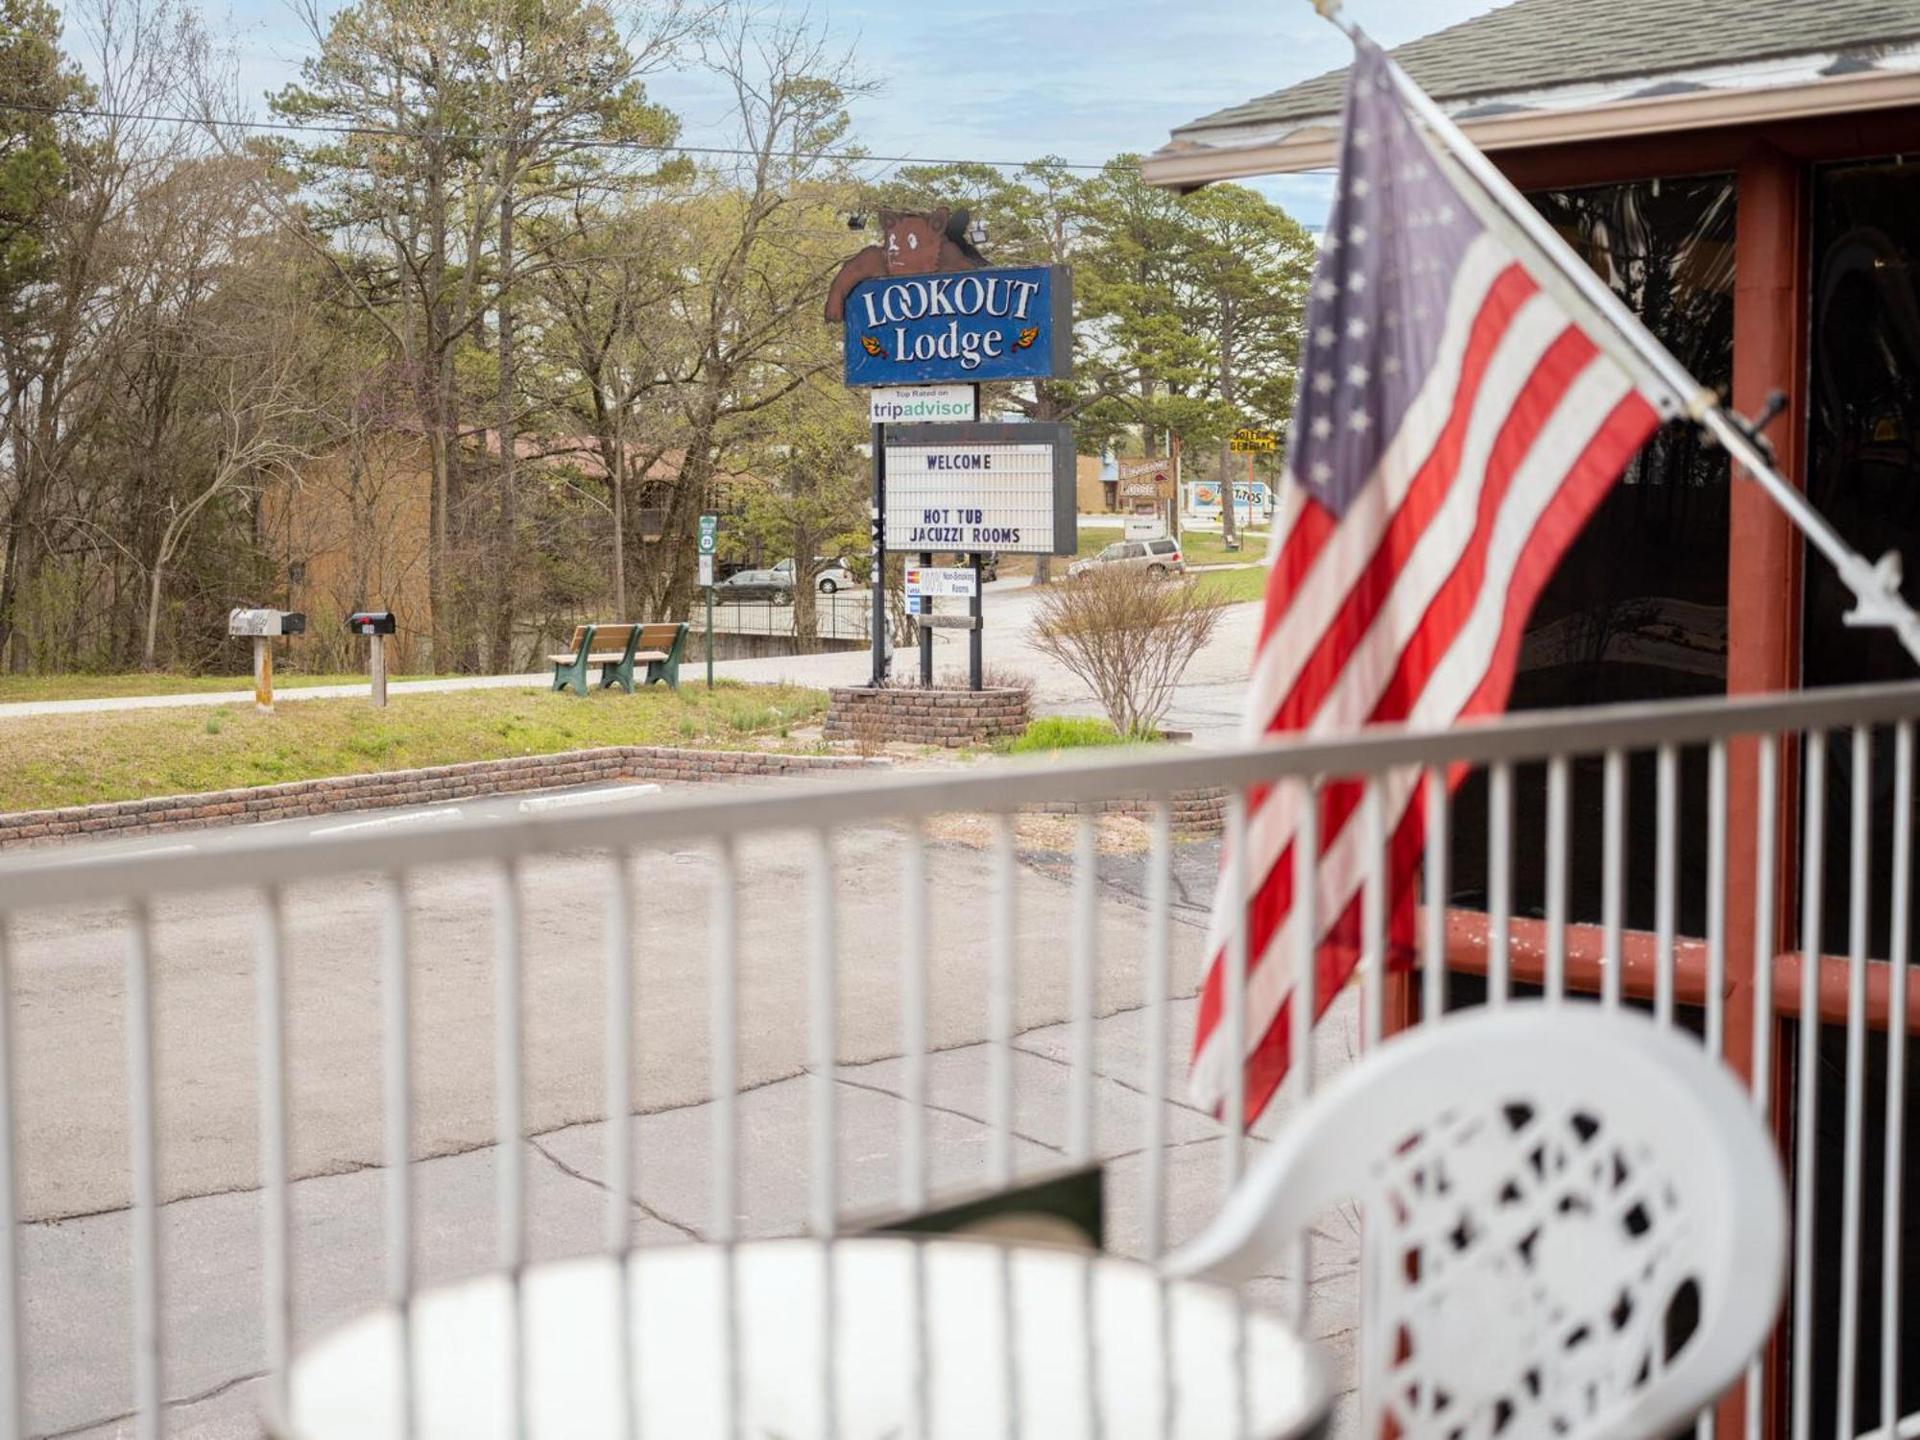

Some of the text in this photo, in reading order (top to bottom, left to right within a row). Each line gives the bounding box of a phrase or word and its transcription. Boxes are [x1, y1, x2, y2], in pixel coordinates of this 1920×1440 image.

[862, 276, 1039, 328] LOOKOUT
[894, 321, 1002, 369] Lodge
[873, 401, 971, 420] tripadvisor
[927, 454, 991, 470] WELCOME
[923, 509, 983, 525] HOT TUB
[909, 527, 1020, 543] JACUZZI ROOMS
